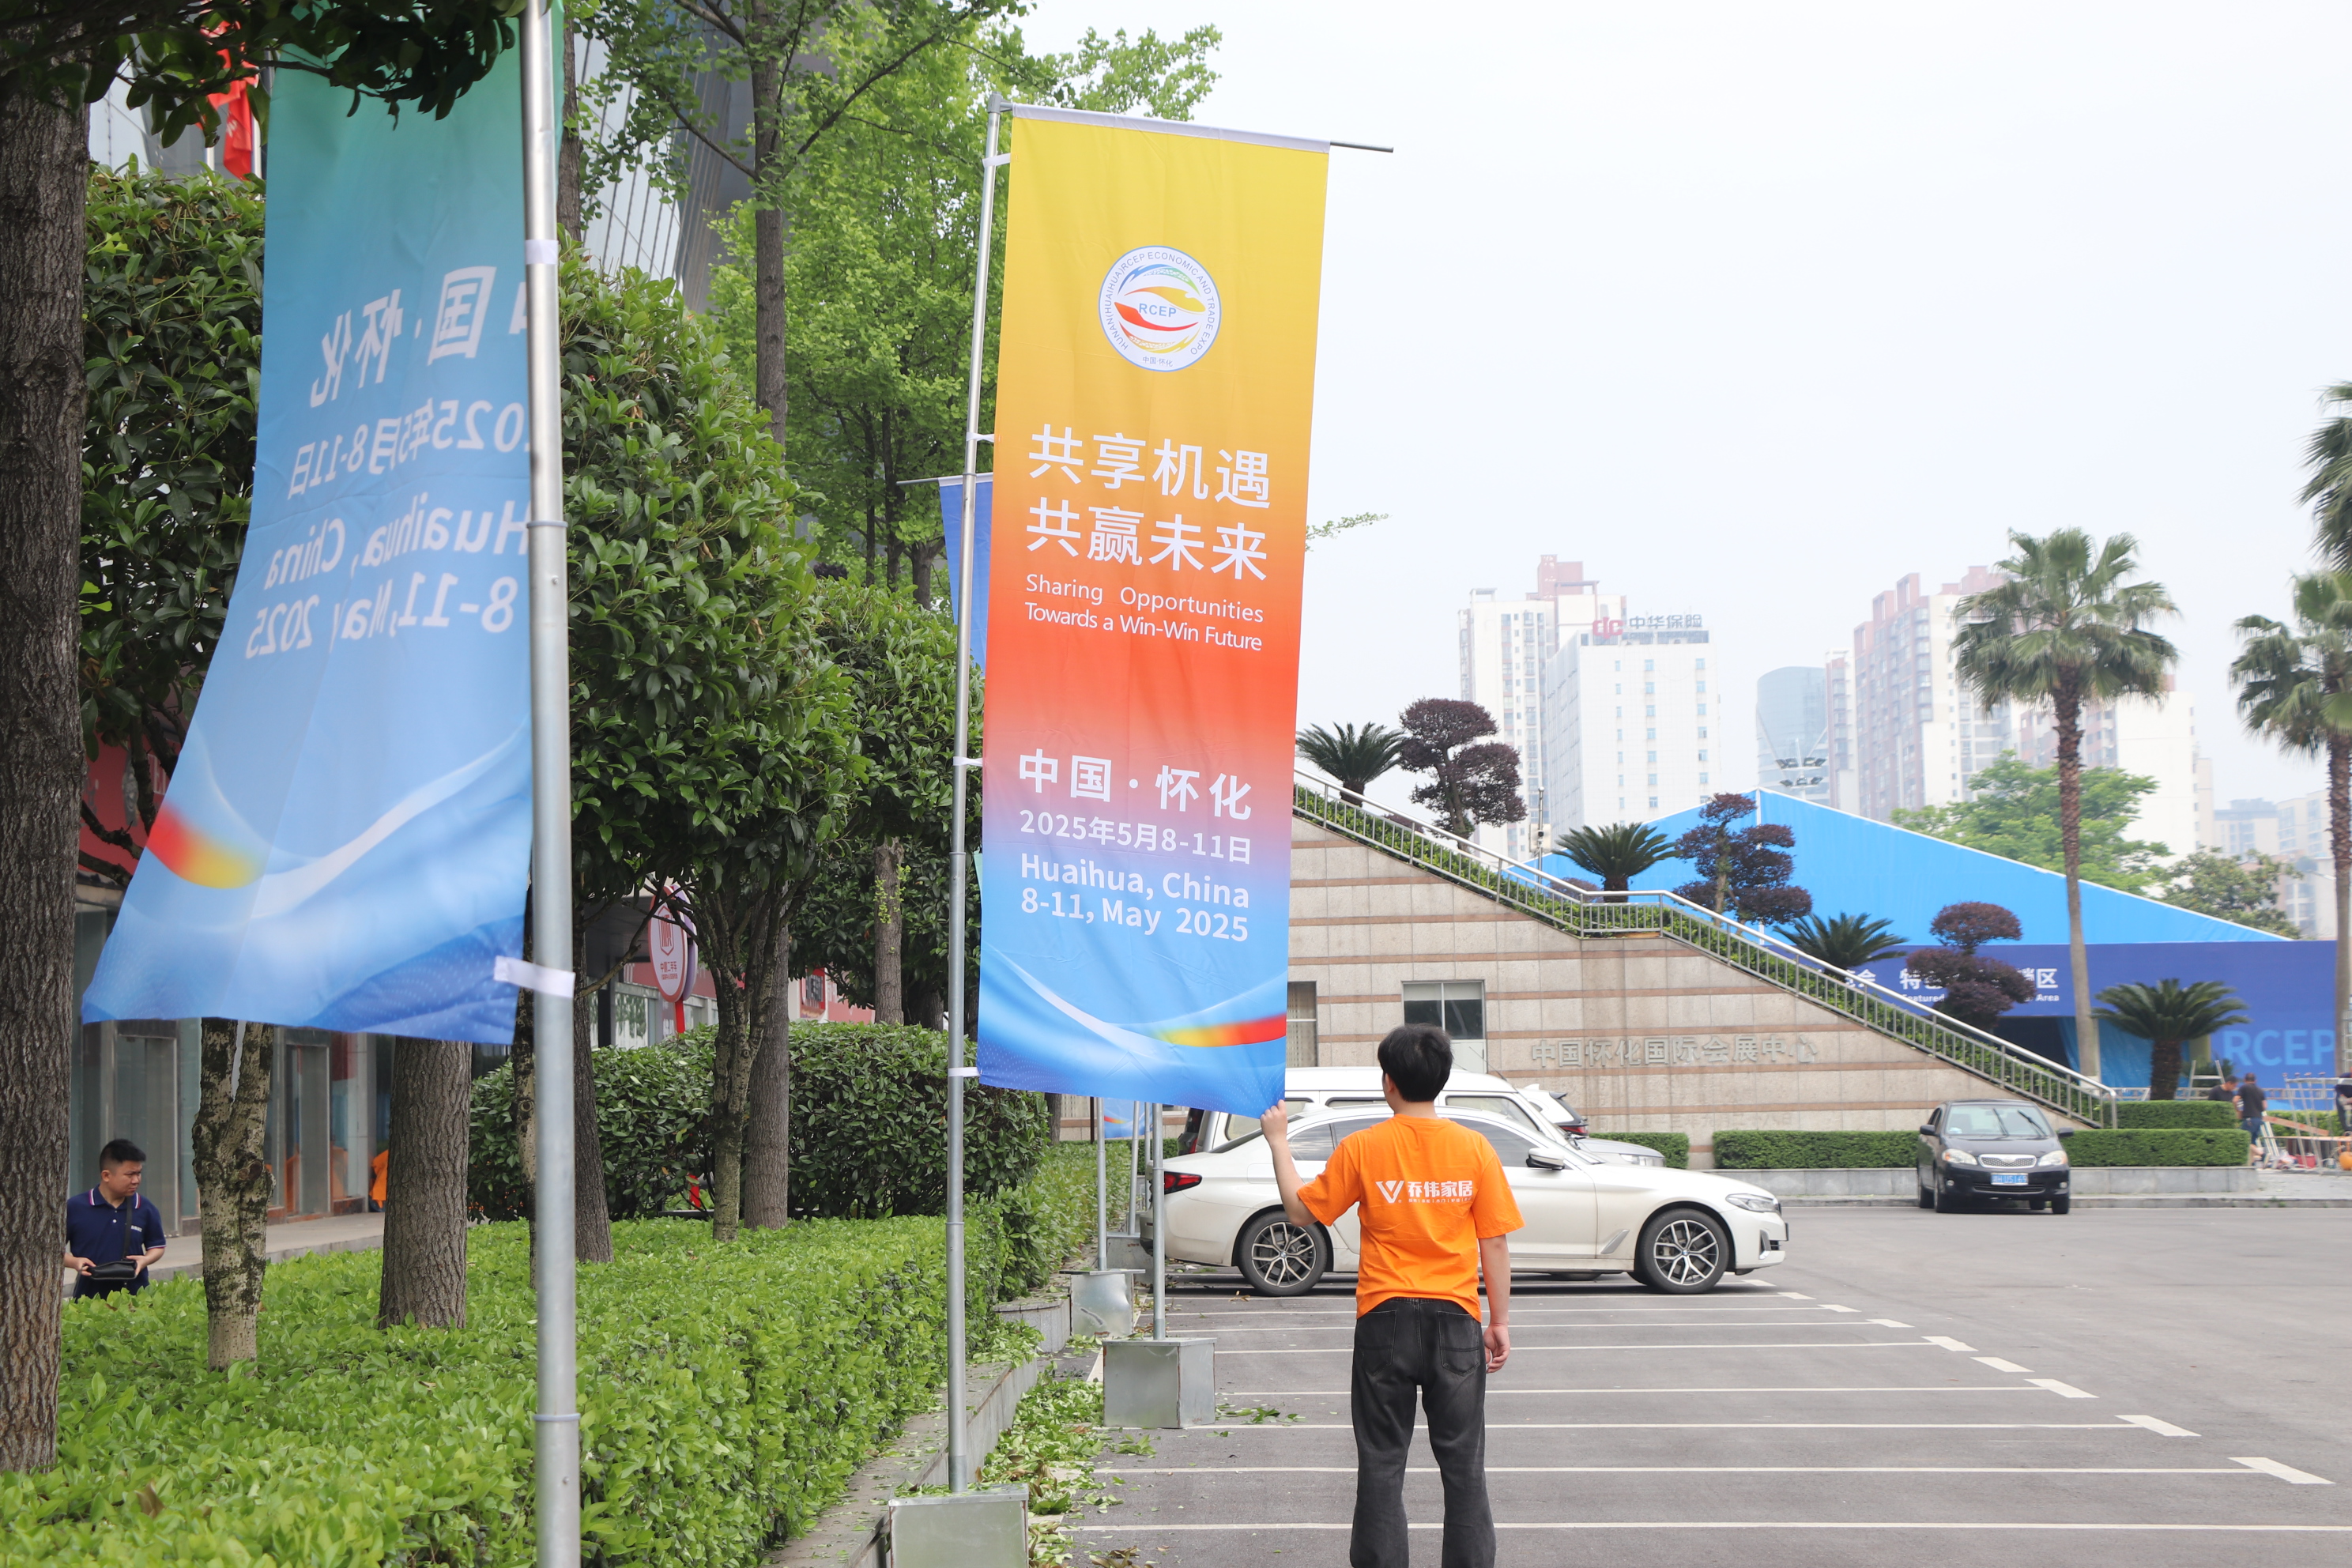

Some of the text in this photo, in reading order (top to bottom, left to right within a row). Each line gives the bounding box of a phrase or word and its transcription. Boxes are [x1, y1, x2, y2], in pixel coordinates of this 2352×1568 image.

[1148, 251, 1199, 276] ECONOMIC
[1197, 276, 1212, 295] AND
[1139, 303, 1177, 317] RCEP
[1205, 296, 1216, 330] TRADE
[1190, 331, 1211, 355] EXPO
[1028, 423, 1271, 509] 共享机遇
[1026, 496, 1268, 582] 共赢未来
[1026, 574, 1264, 623] Sharing Opportunities
[1024, 602, 1263, 651] Towards a Win-Win Future
[1629, 614, 1703, 630] 中华保险
[1019, 748, 1253, 820] 中国·怀化
[1020, 809, 1251, 865] 2025年5月8-11日
[1021, 853, 1250, 908] Huaihua, China
[1021, 888, 1249, 942] 8-11, May 2025
[2035, 993, 2060, 1002] Area
[1532, 1035, 1818, 1067] 中国怀化国际会展中心
[2223, 1029, 2336, 1066] RCEP
